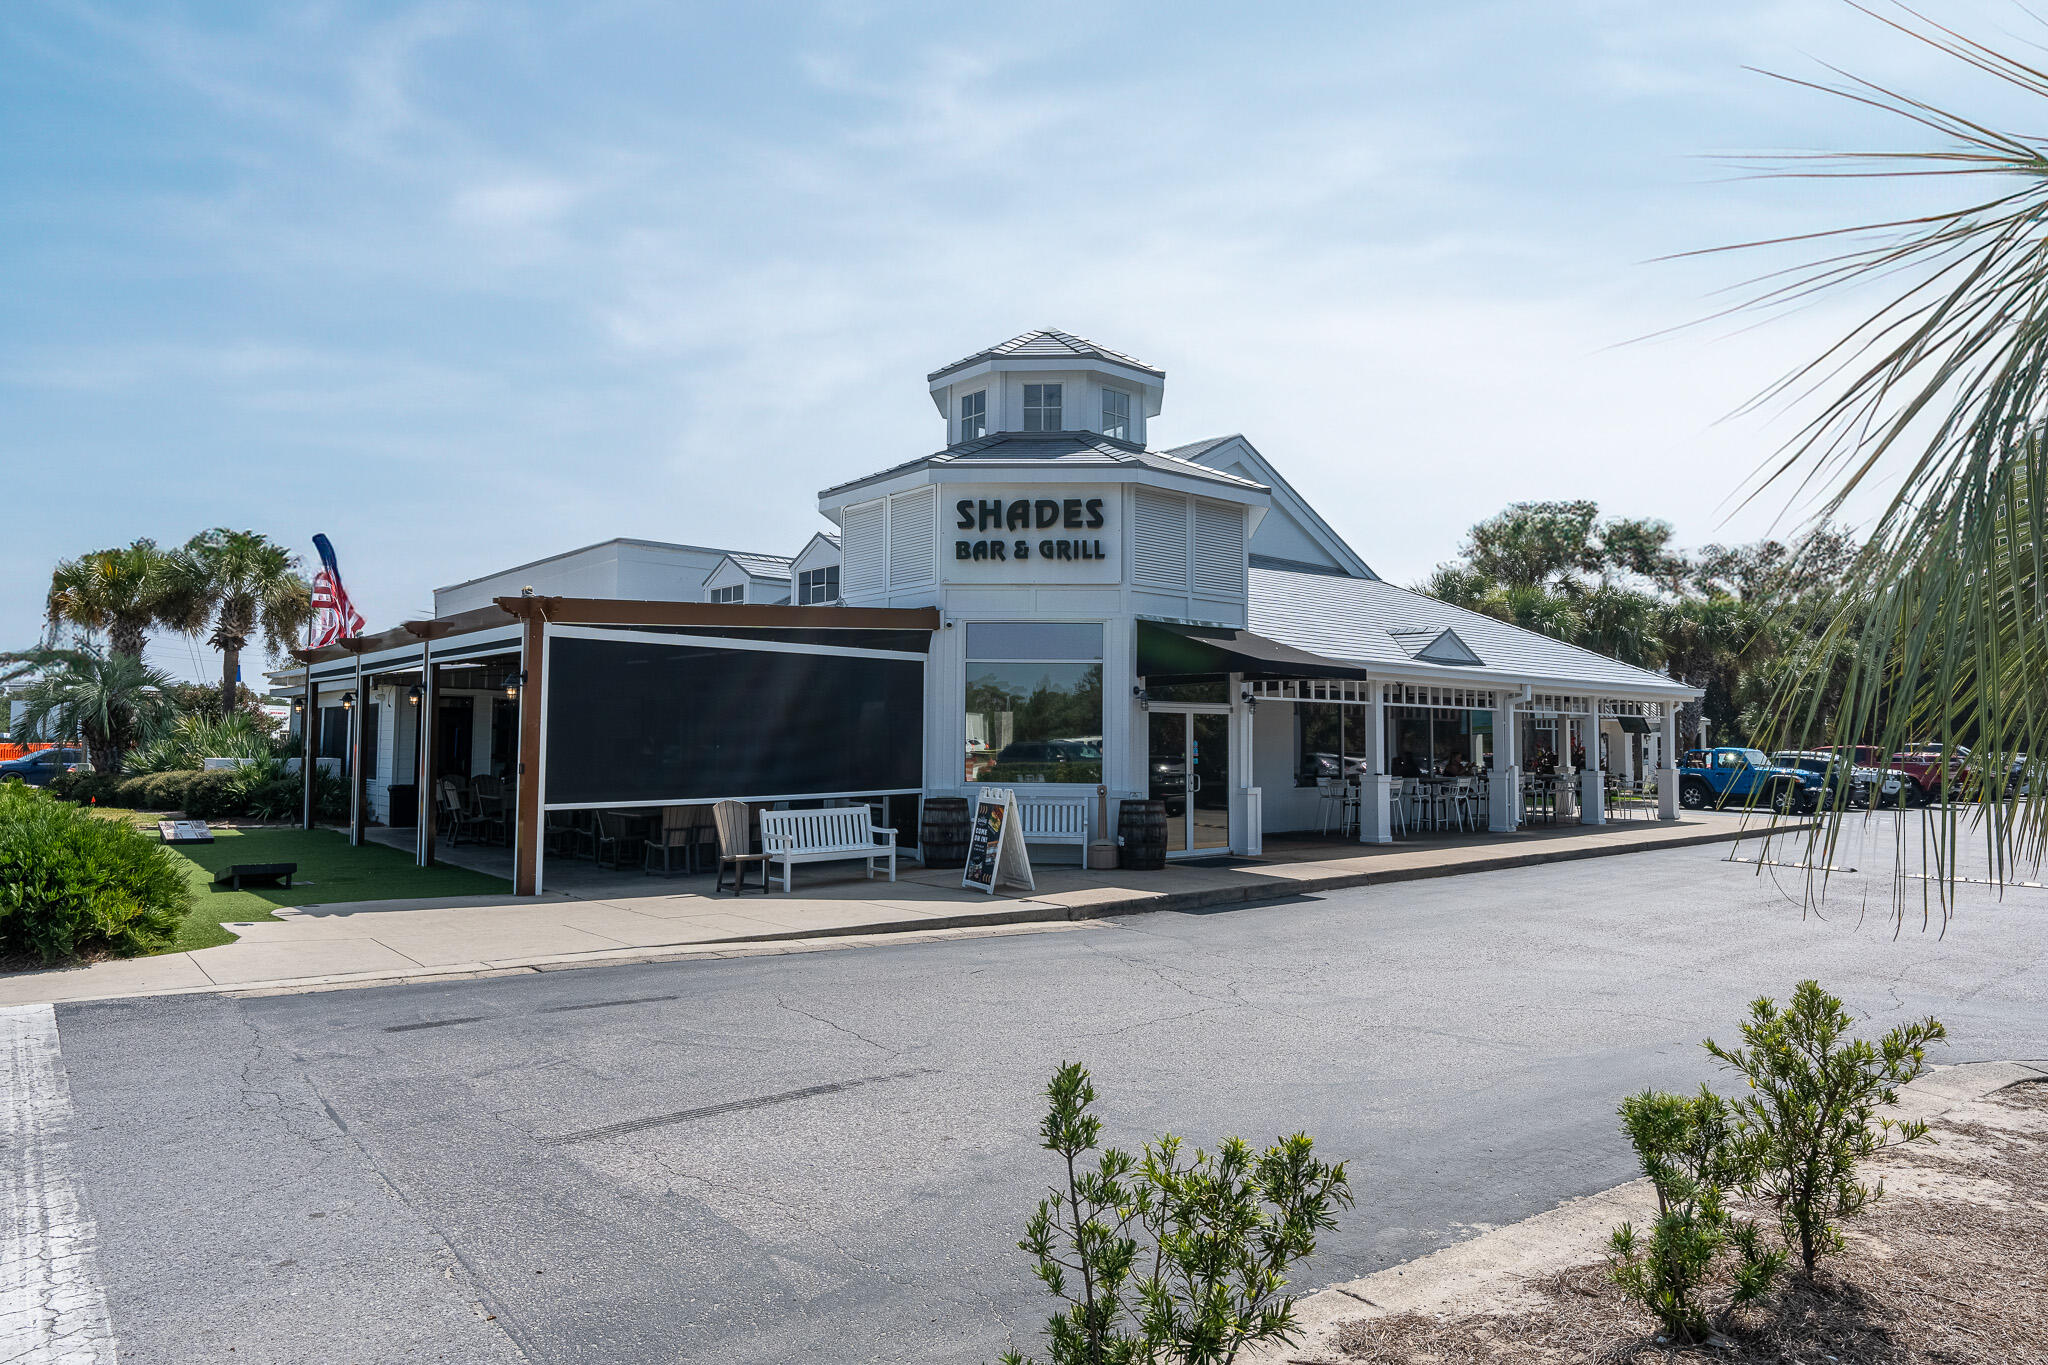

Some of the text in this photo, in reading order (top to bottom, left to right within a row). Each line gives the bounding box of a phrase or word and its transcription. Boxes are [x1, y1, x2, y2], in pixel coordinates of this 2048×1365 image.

[956, 499, 1104, 532] SHADES
[955, 540, 1105, 562] BAR & GRILL
